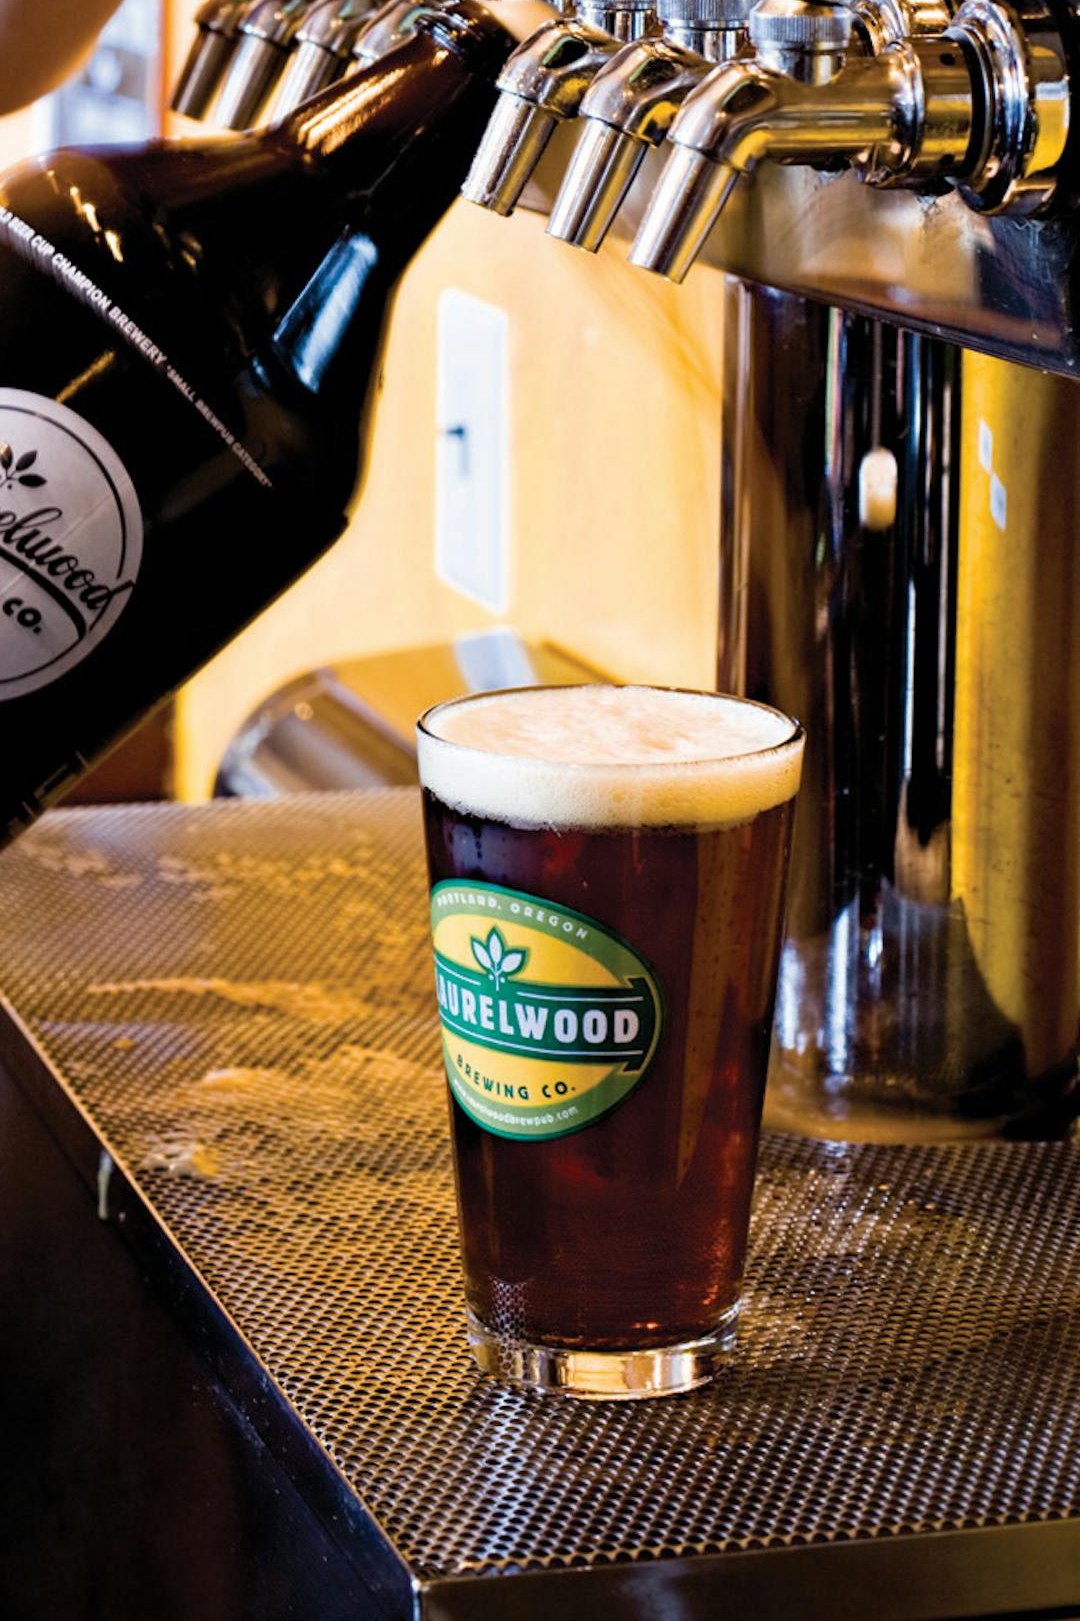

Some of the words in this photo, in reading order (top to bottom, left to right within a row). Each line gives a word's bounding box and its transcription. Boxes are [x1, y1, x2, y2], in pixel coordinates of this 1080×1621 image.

[31, 234, 55, 256] CUP
[52, 252, 112, 312] CHAMPION
[109, 306, 168, 365] BREWERY
[2, 597, 42, 635] CO.
[509, 902, 589, 940] OREGON
[457, 1053, 530, 1101] BREWING
[542, 1081, 576, 1098] CO.
